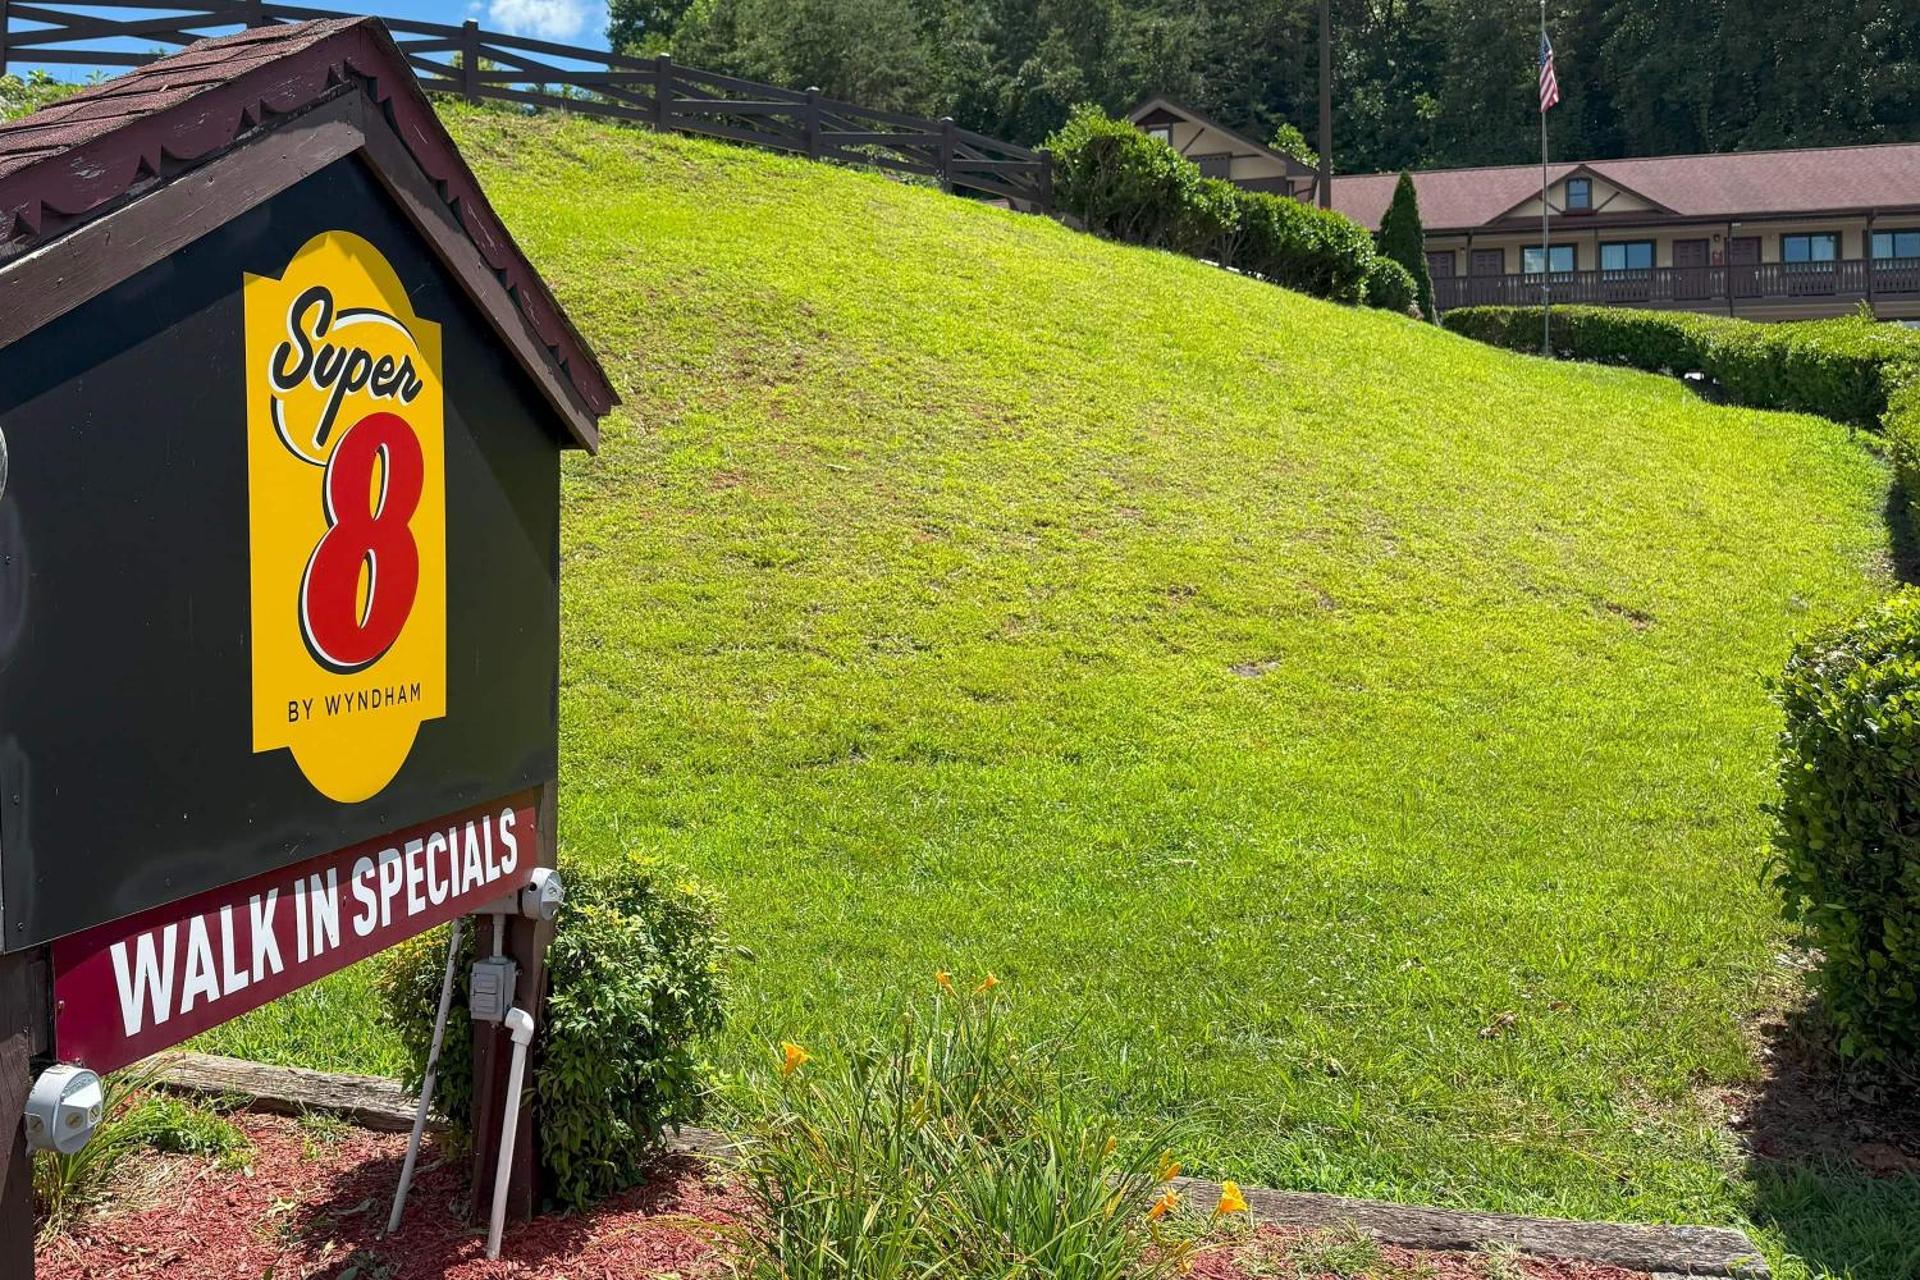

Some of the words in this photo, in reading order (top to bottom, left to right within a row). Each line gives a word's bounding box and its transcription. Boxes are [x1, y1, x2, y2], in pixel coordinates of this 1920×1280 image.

[268, 286, 424, 450] Super
[298, 411, 425, 675] 8
[288, 698, 313, 722] BY
[324, 682, 421, 717] WYNDHAM
[110, 887, 285, 1038] WALK
[294, 867, 340, 963] IN
[351, 807, 518, 937] SPECIALS
